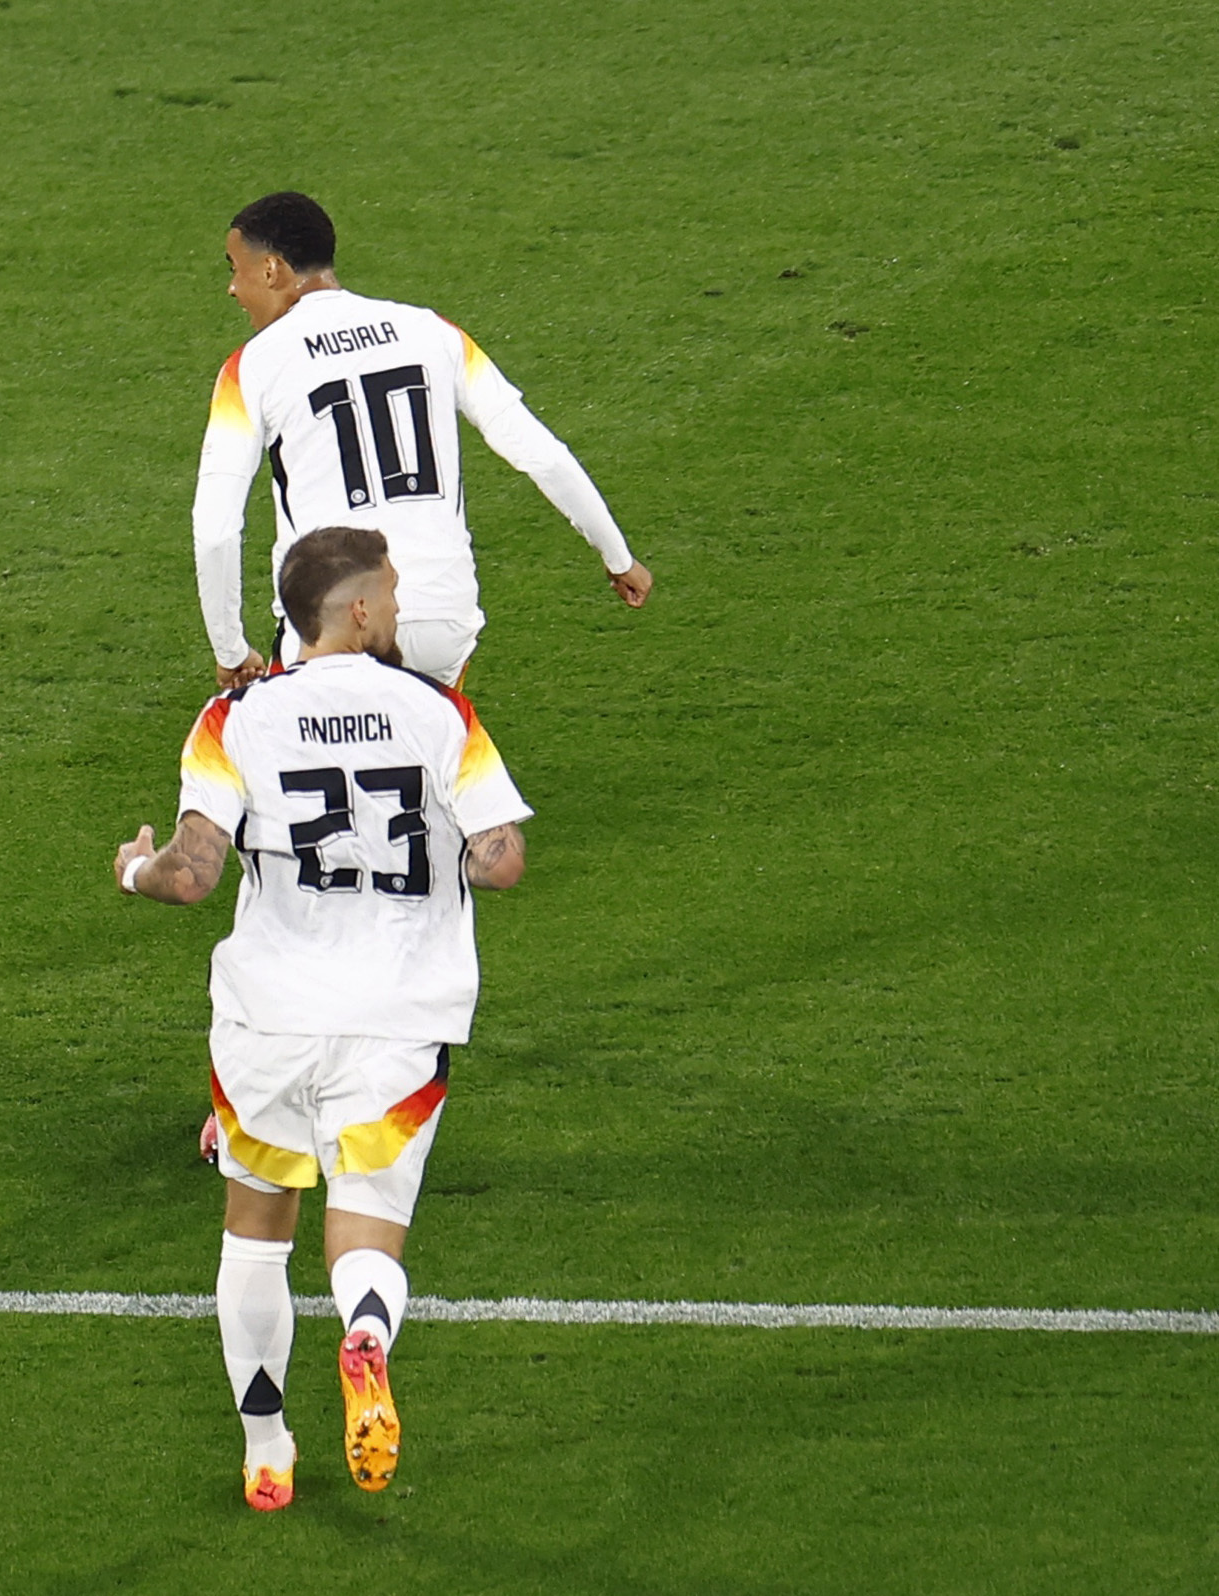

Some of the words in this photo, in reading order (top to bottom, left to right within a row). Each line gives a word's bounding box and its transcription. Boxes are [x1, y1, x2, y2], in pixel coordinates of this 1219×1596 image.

[303, 321, 399, 359] MUSIALA
[308, 364, 445, 511] 10
[298, 713, 392, 744] ANDRICH
[279, 765, 431, 901] 23
